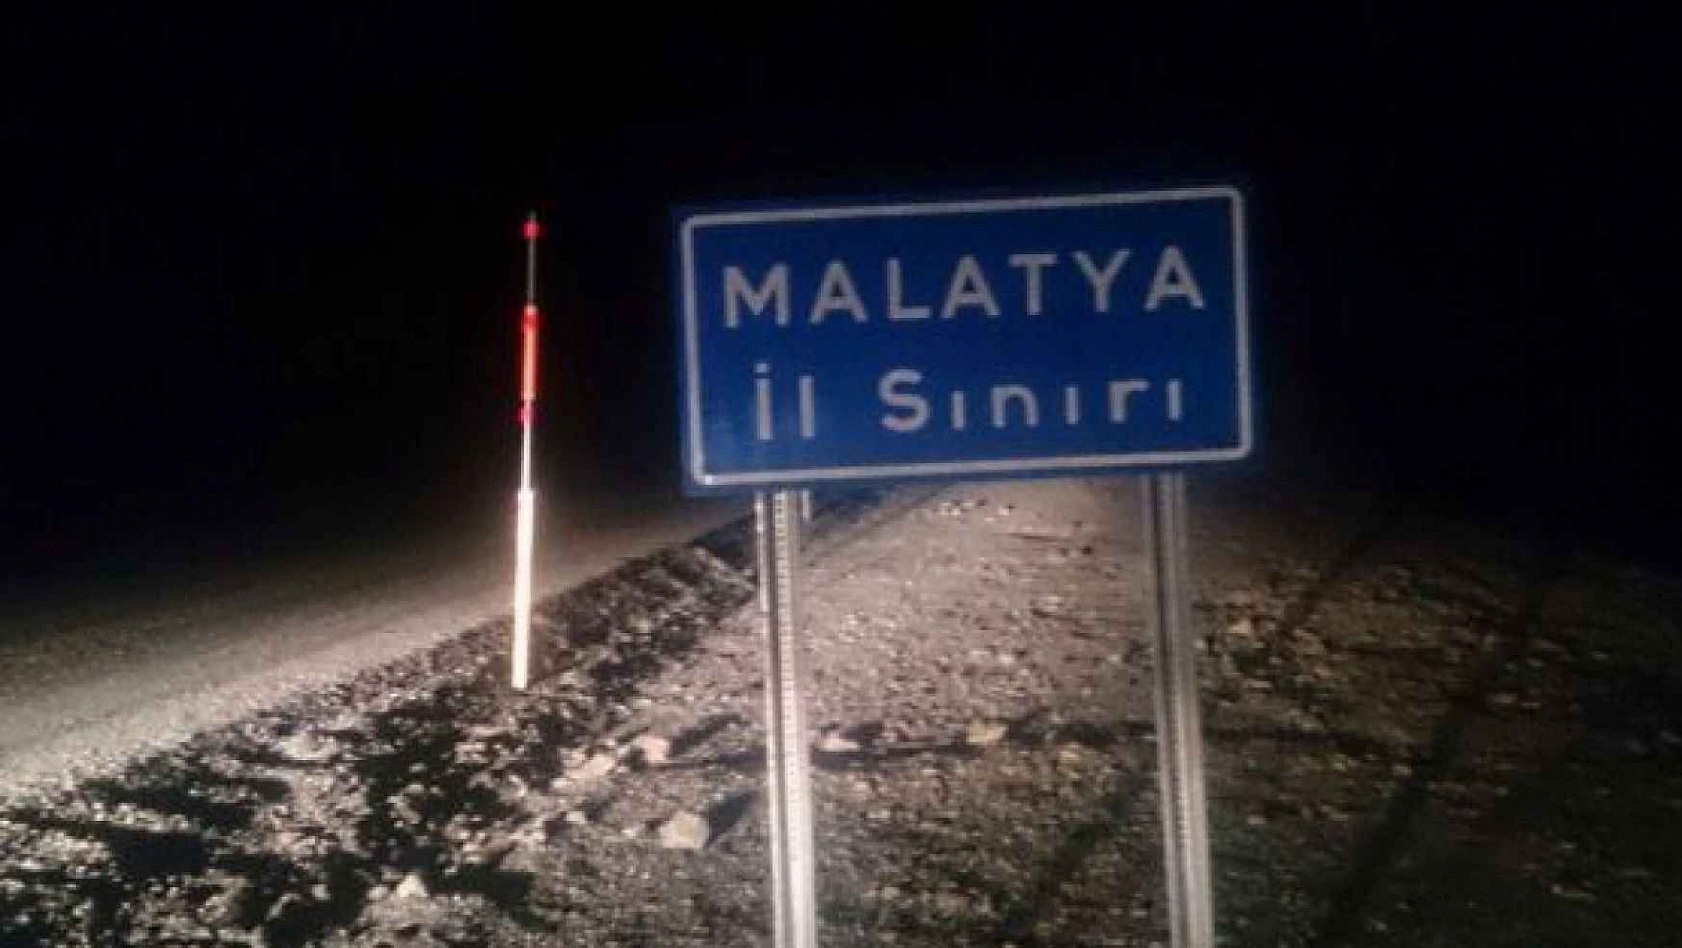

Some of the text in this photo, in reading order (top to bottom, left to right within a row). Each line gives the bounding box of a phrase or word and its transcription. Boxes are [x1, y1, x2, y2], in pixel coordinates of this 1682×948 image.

[724, 245, 1205, 328] MALATYA
[754, 362, 1183, 441] İl Sınırı
